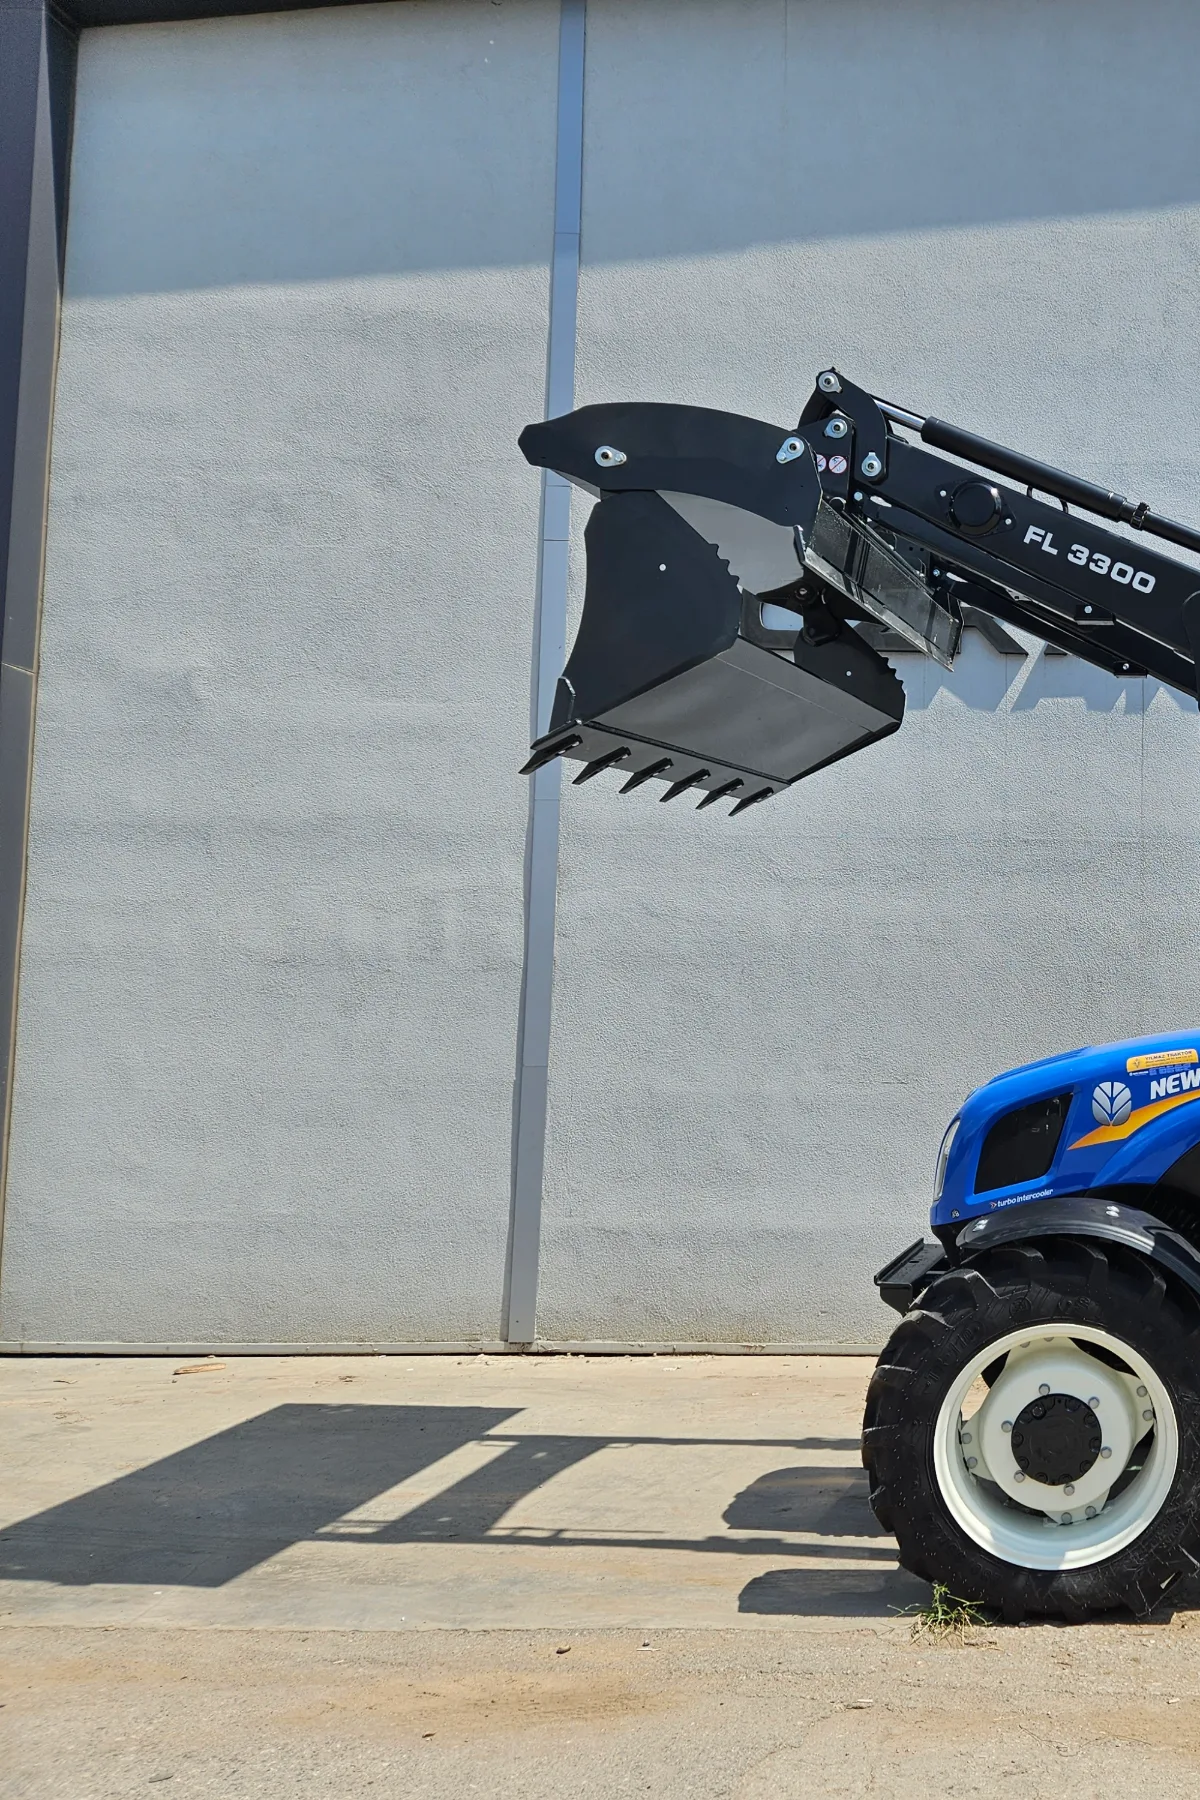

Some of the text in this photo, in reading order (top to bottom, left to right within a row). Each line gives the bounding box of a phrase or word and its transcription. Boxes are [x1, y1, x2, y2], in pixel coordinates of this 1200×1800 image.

[1023, 524, 1156, 594] FL 3300
[997, 1189, 1054, 1207] turbo intercooler
